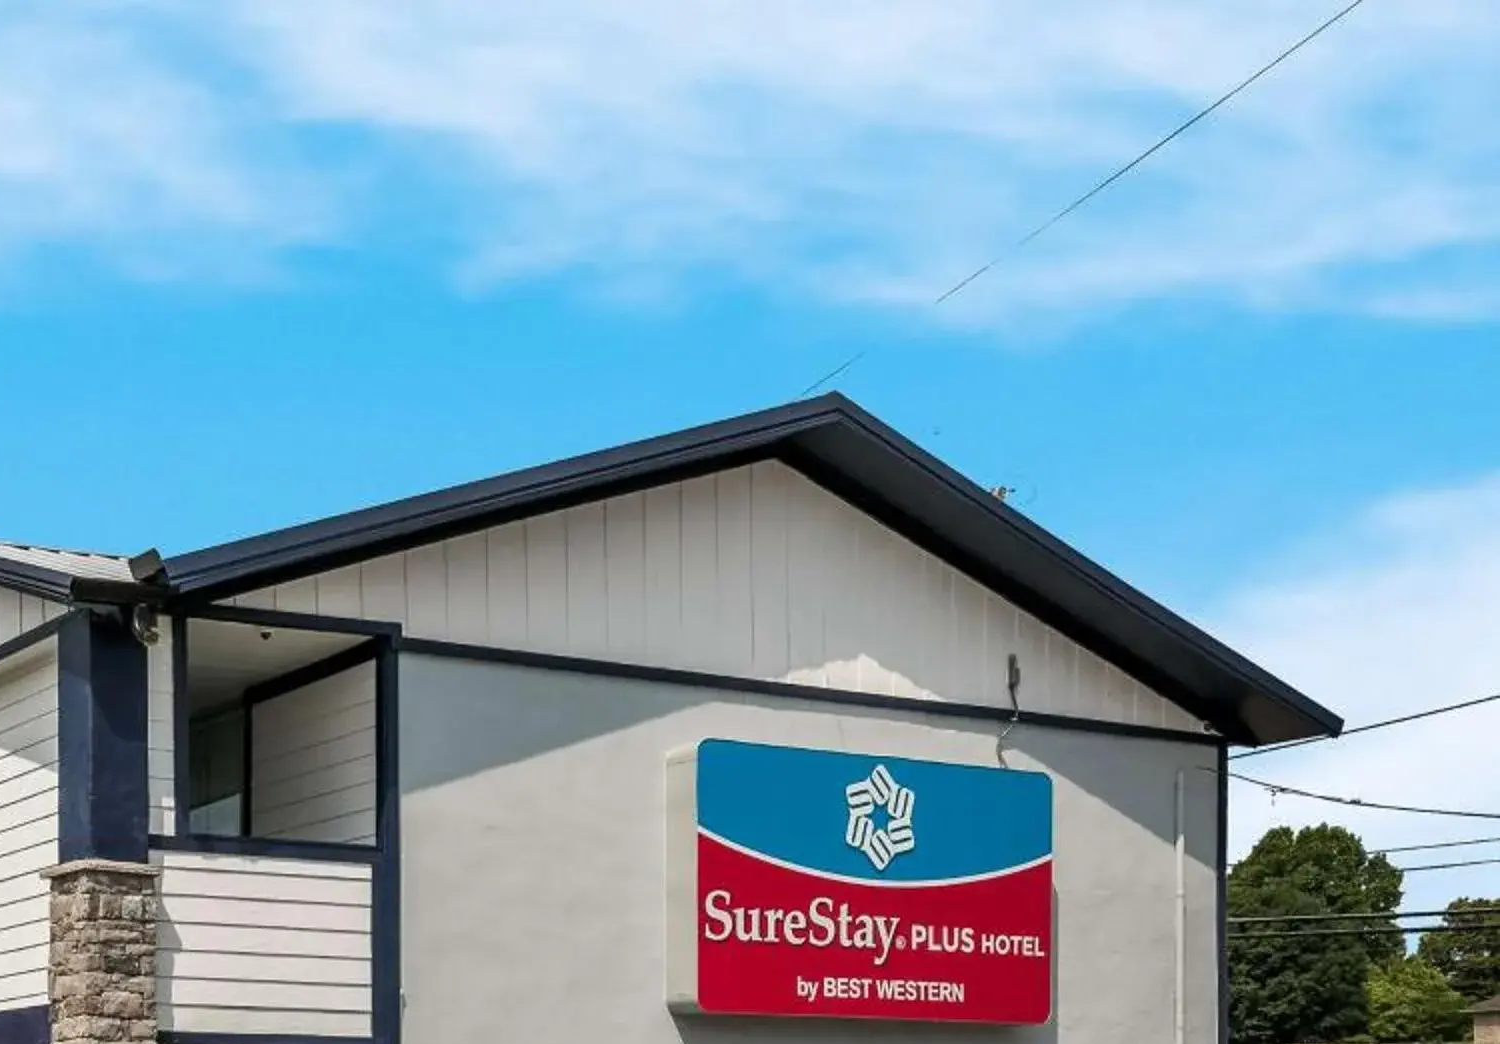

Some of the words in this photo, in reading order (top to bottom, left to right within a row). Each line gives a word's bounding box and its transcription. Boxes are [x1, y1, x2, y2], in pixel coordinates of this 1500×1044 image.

[911, 925, 976, 954] PLUS
[981, 935, 1045, 957] HOTEL
[797, 975, 819, 1000] by
[823, 977, 872, 999] BEST
[876, 979, 965, 1002] WESTERN
